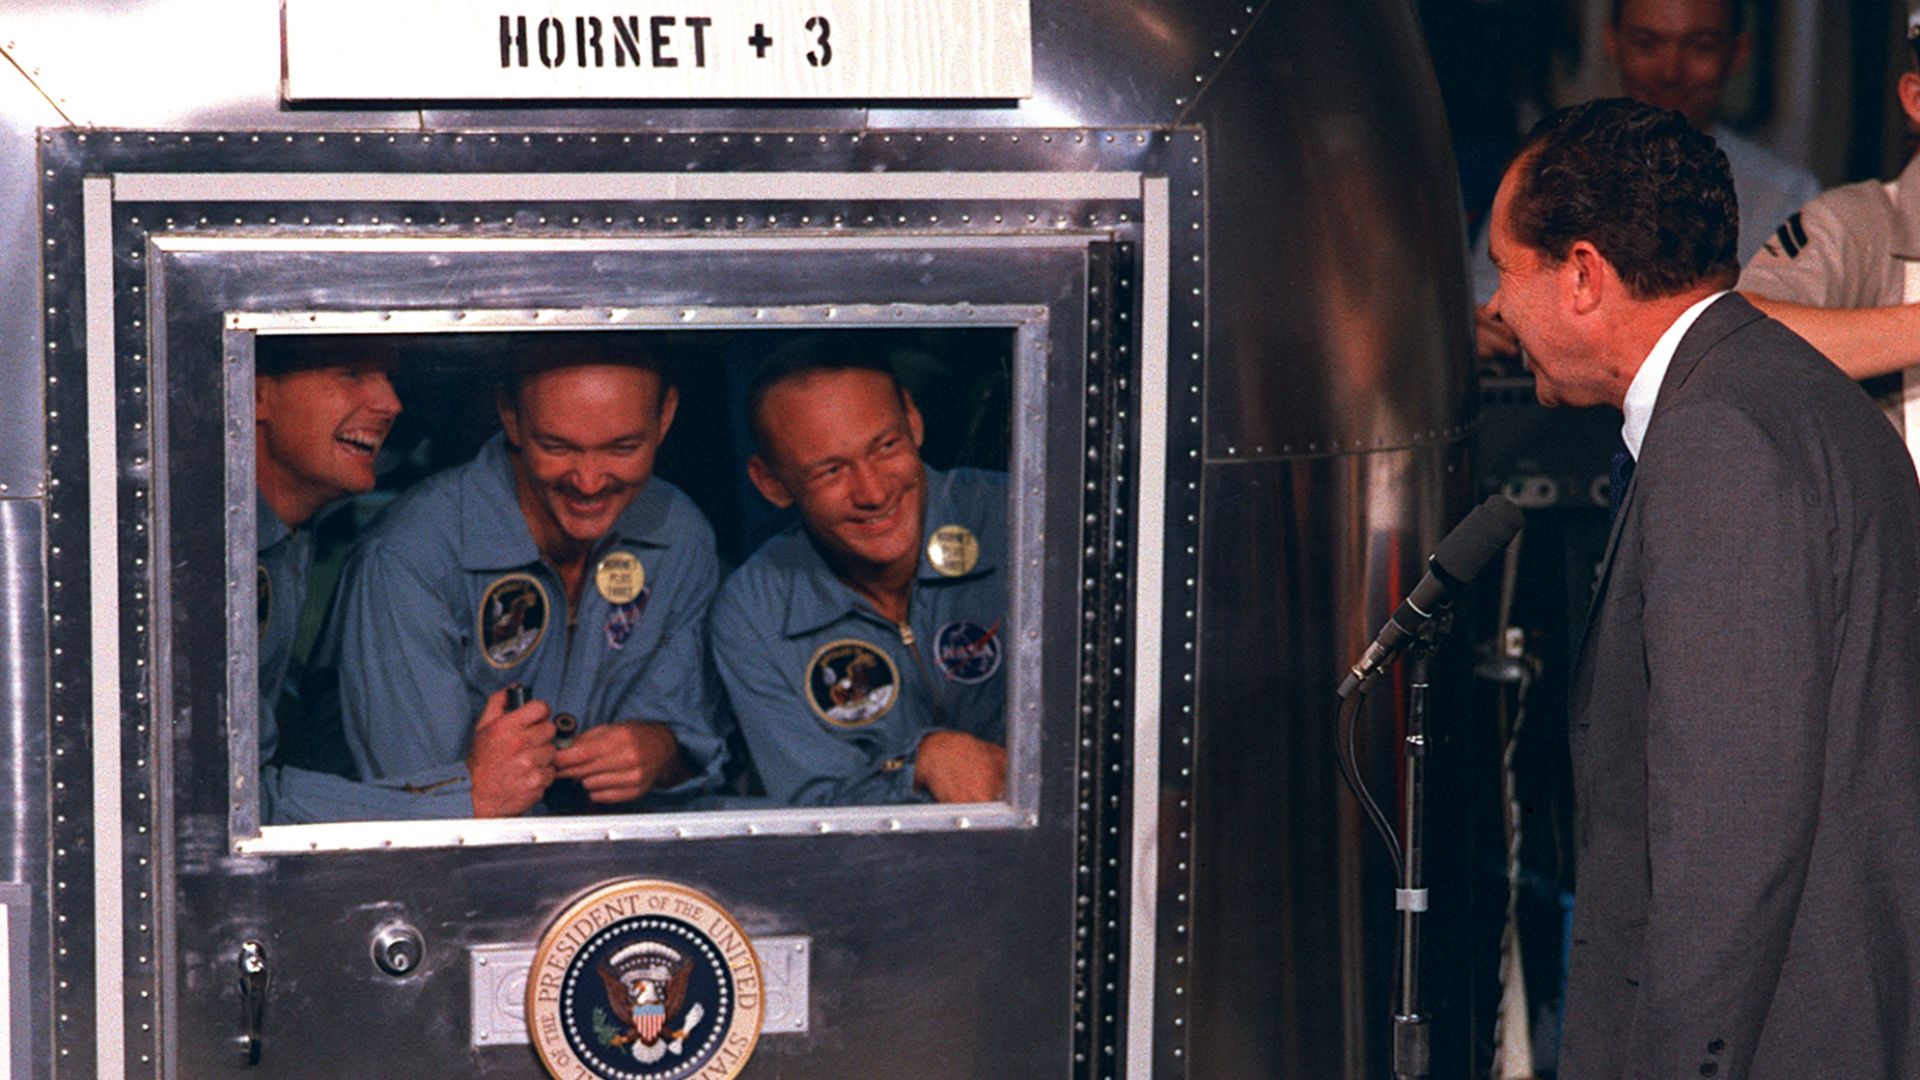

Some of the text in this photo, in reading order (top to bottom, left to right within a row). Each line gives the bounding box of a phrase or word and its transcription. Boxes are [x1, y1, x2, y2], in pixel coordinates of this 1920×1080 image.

[499, 15, 833, 68] HORNET + 3
[648, 895, 670, 911] OF
[674, 898, 705, 920] THE
[538, 894, 640, 1002] PRESIDENT
[708, 917, 758, 1011] UNITED
[541, 1012, 559, 1045] THE
[550, 1048, 570, 1067] OF
